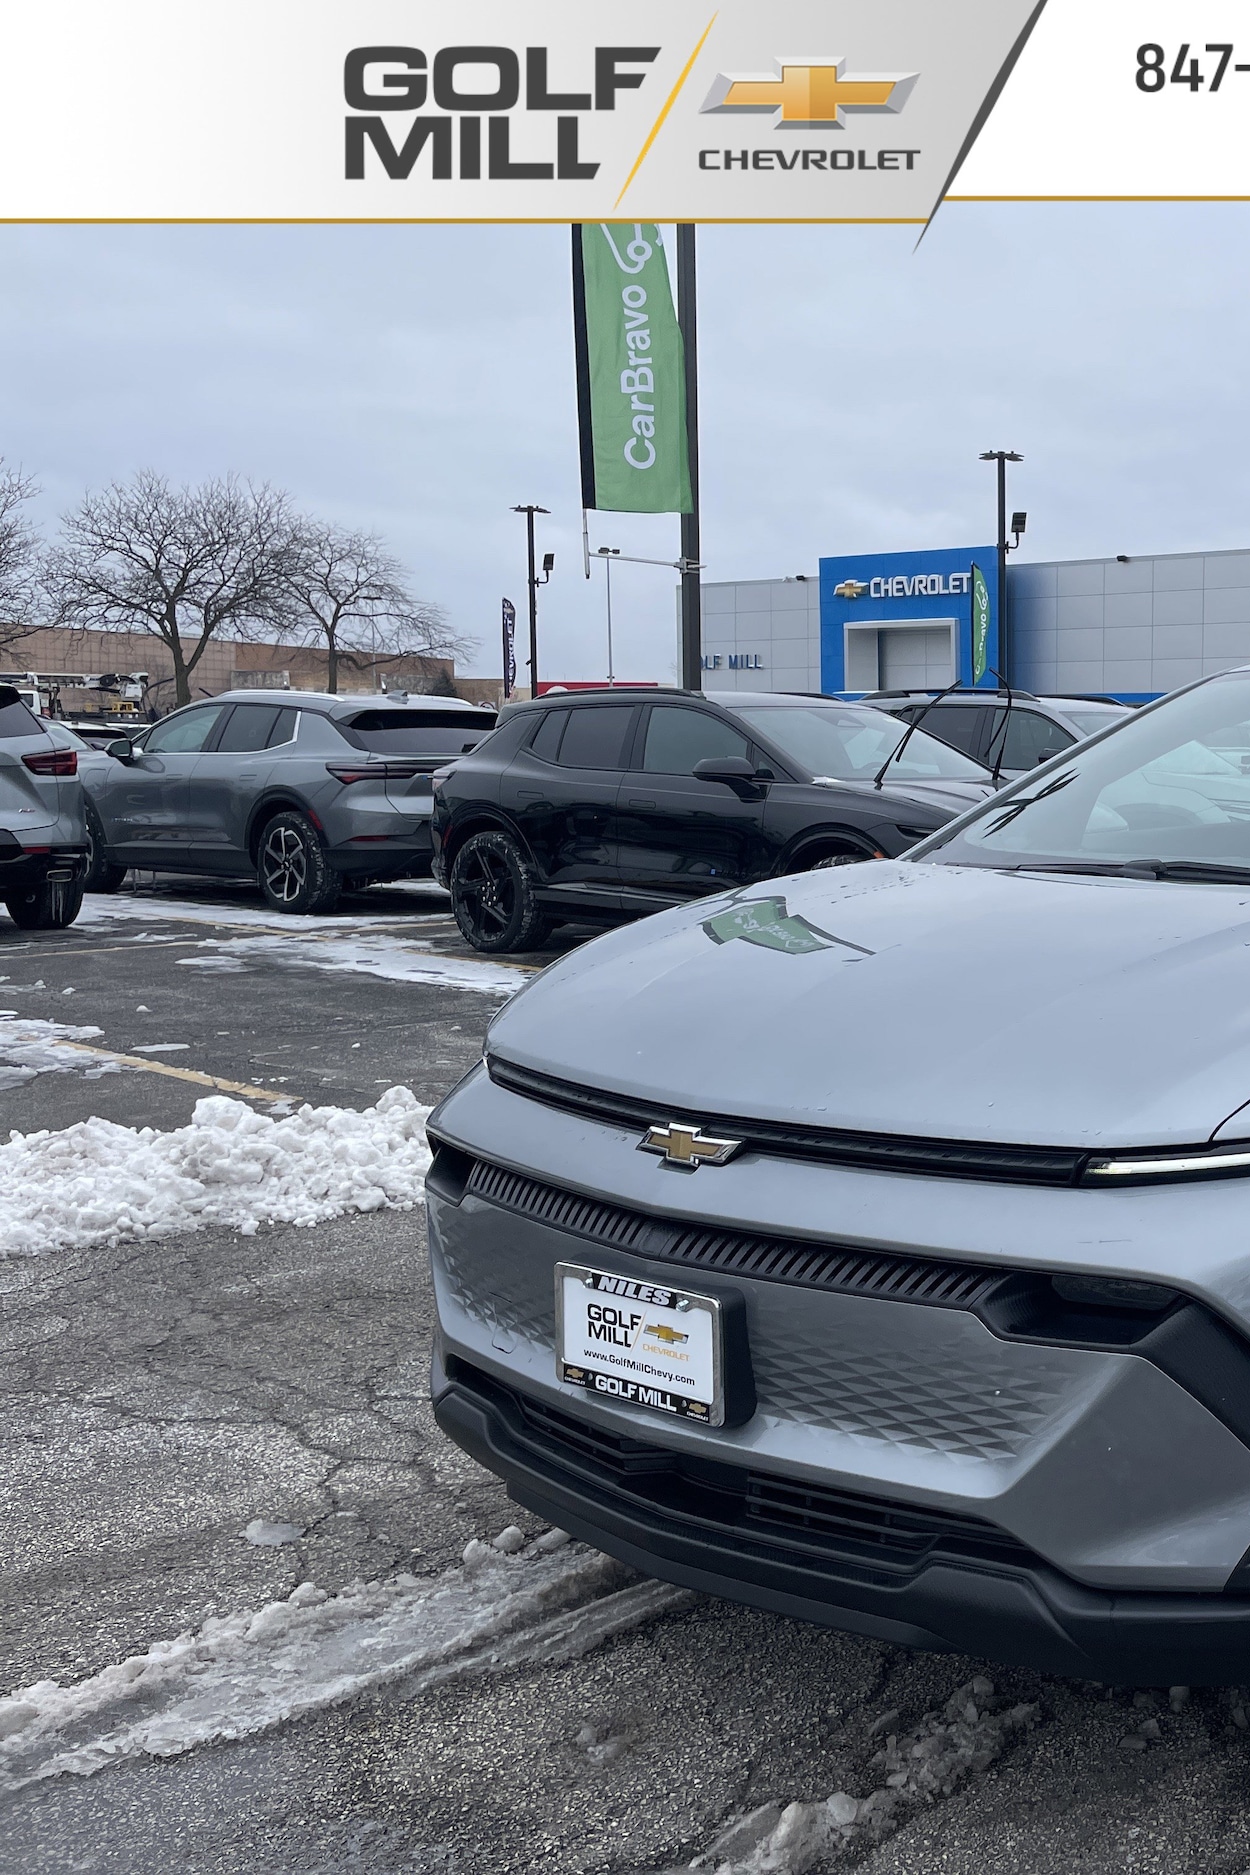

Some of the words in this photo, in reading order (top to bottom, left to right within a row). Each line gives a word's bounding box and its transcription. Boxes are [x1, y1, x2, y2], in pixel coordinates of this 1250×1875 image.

[621, 284, 656, 470] CarBravo
[869, 572, 972, 598] CHEVROLET
[728, 654, 763, 670] MILL
[597, 1275, 672, 1306] NILES
[587, 1303, 642, 1331] GOLF
[588, 1320, 632, 1348] MILL
[642, 1343, 690, 1361] CHEVROLET
[583, 1349, 696, 1386] www.GolfMillChevy.com
[595, 1374, 638, 1399] GOLF
[638, 1386, 677, 1412] MILL
